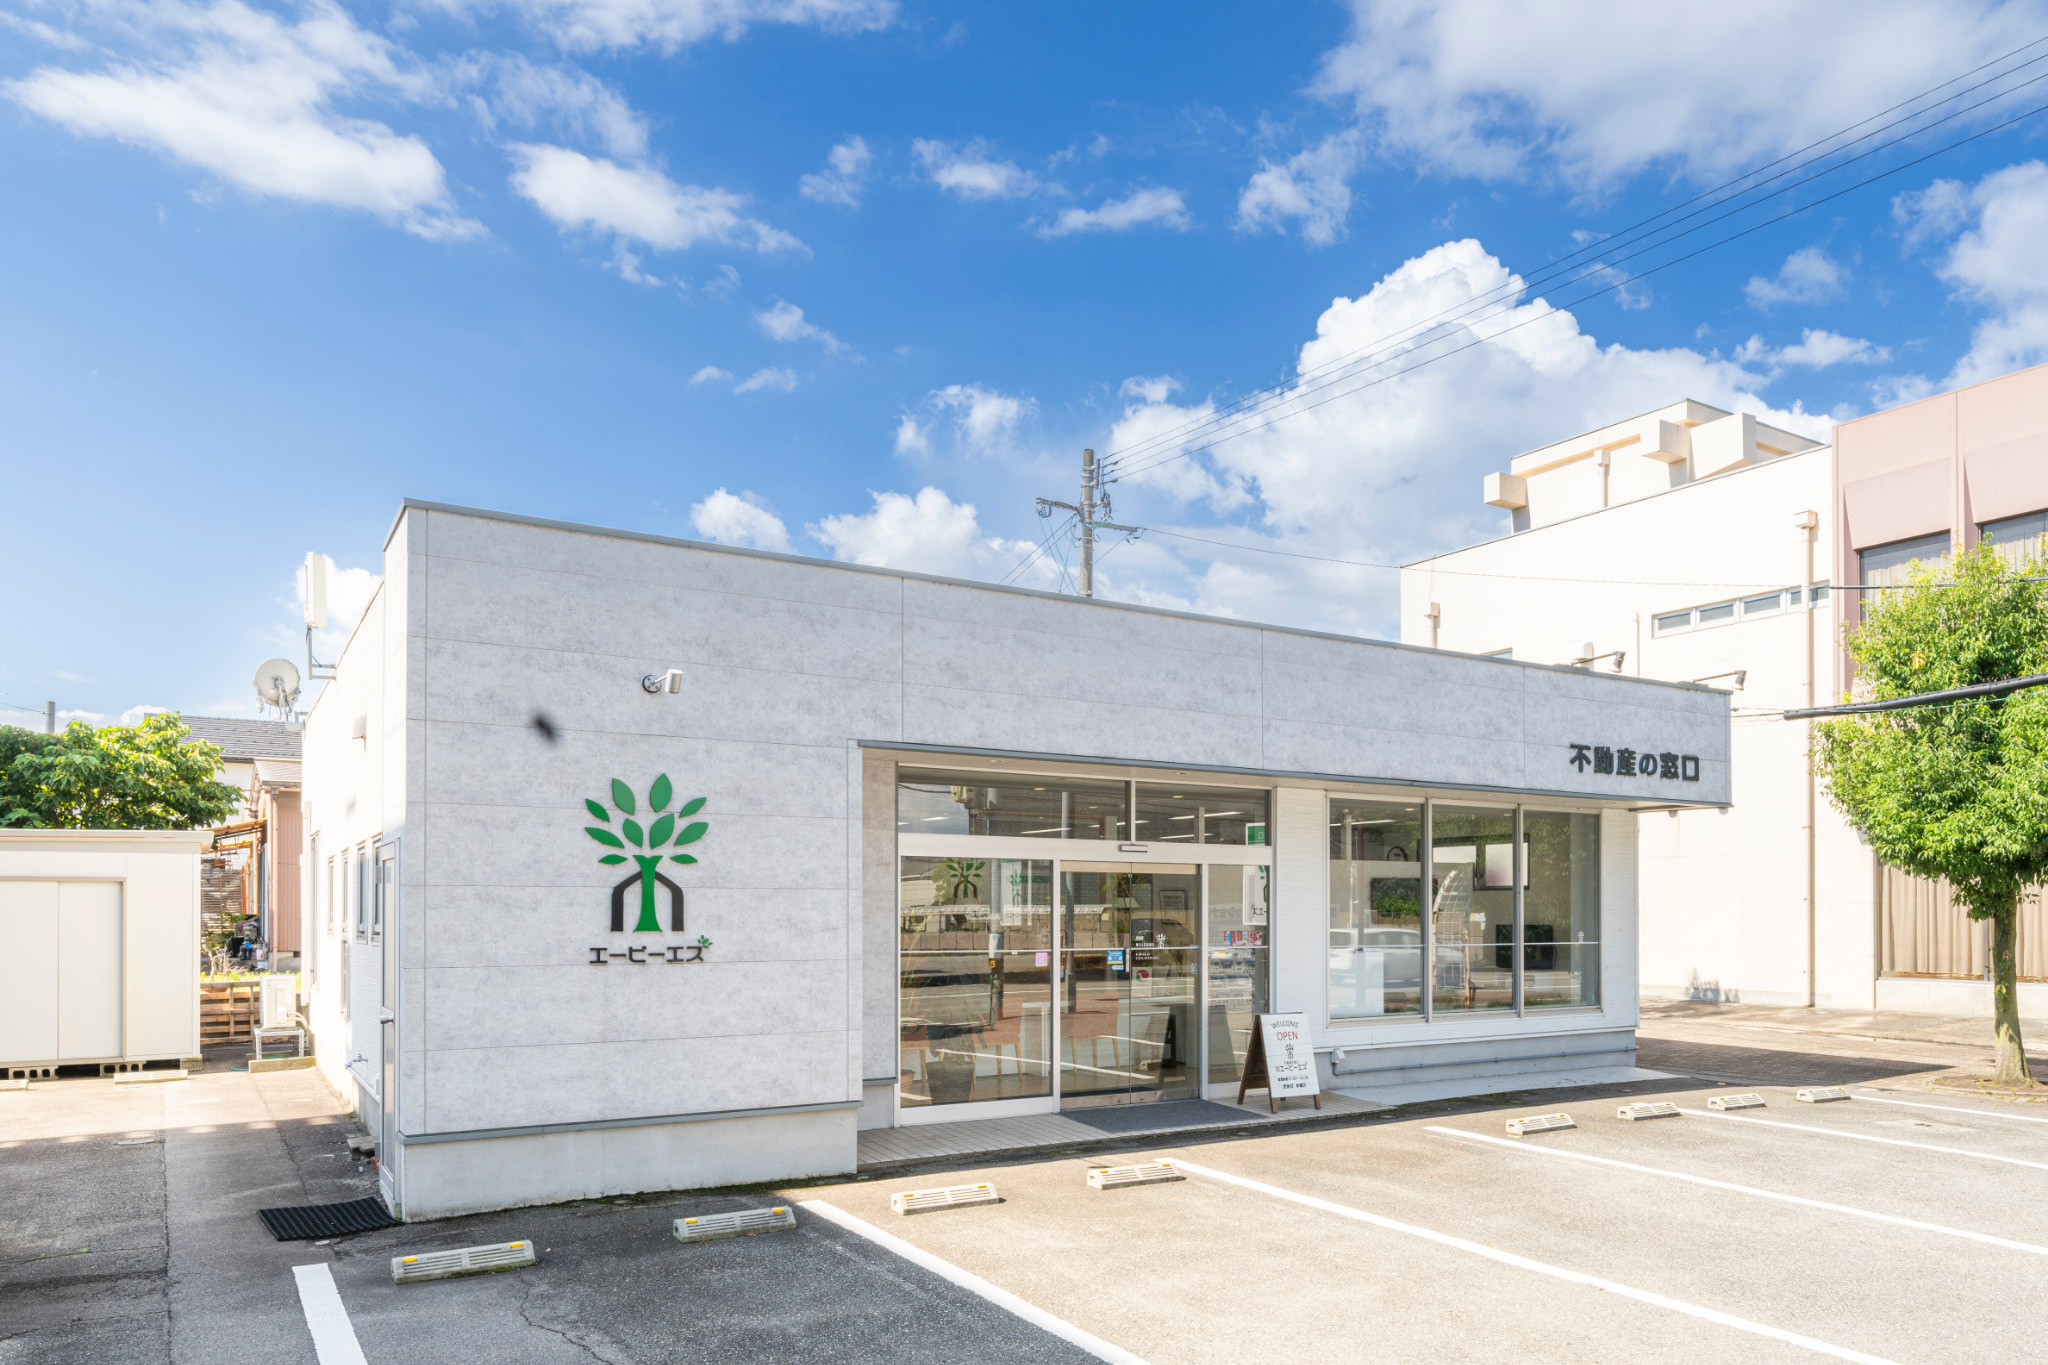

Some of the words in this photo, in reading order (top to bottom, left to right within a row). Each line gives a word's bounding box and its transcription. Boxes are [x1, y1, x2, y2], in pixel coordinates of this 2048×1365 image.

[1569, 743, 1700, 782] 不動産の窓口
[589, 945, 704, 964] エービーエス
[1271, 1020, 1299, 1029] WELCOME
[1277, 1031, 1298, 1041] OPEN
